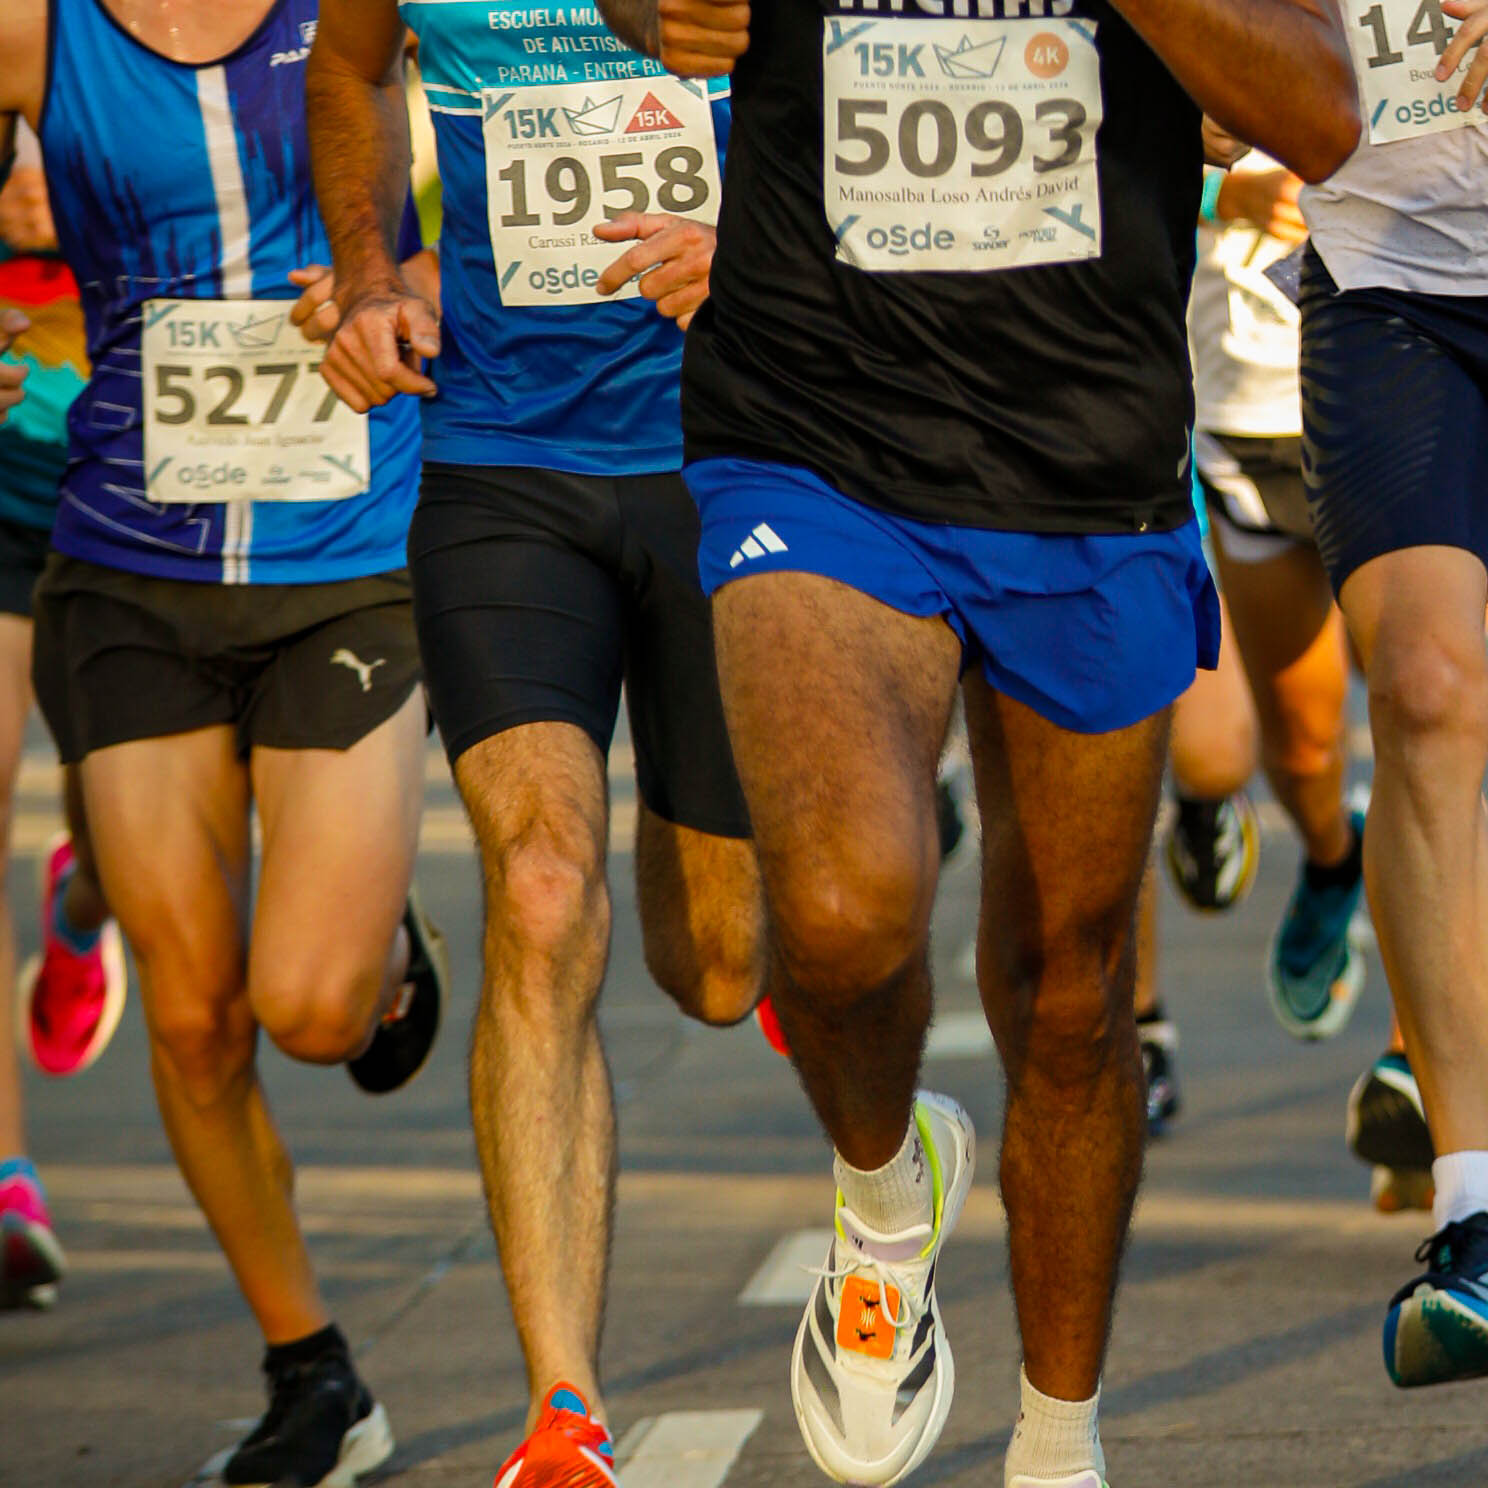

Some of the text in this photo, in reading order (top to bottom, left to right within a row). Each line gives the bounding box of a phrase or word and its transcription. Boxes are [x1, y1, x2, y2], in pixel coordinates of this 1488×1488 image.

[488, 8, 567, 30] ESCUELA
[523, 38, 548, 54] DE
[1032, 48, 1060, 65] 4K
[584, 61, 639, 80] ENTRE
[854, 44, 926, 77] 15K
[504, 108, 560, 139] 15K
[636, 109, 670, 128] 15K
[834, 98, 1087, 179] 5093
[499, 145, 709, 227] 1958
[839, 177, 1079, 203] Manosalba Loso Andrés David
[528, 234, 576, 249] Carussi
[866, 223, 955, 256] osde
[529, 264, 599, 294] osde
[165, 321, 222, 348] 15K
